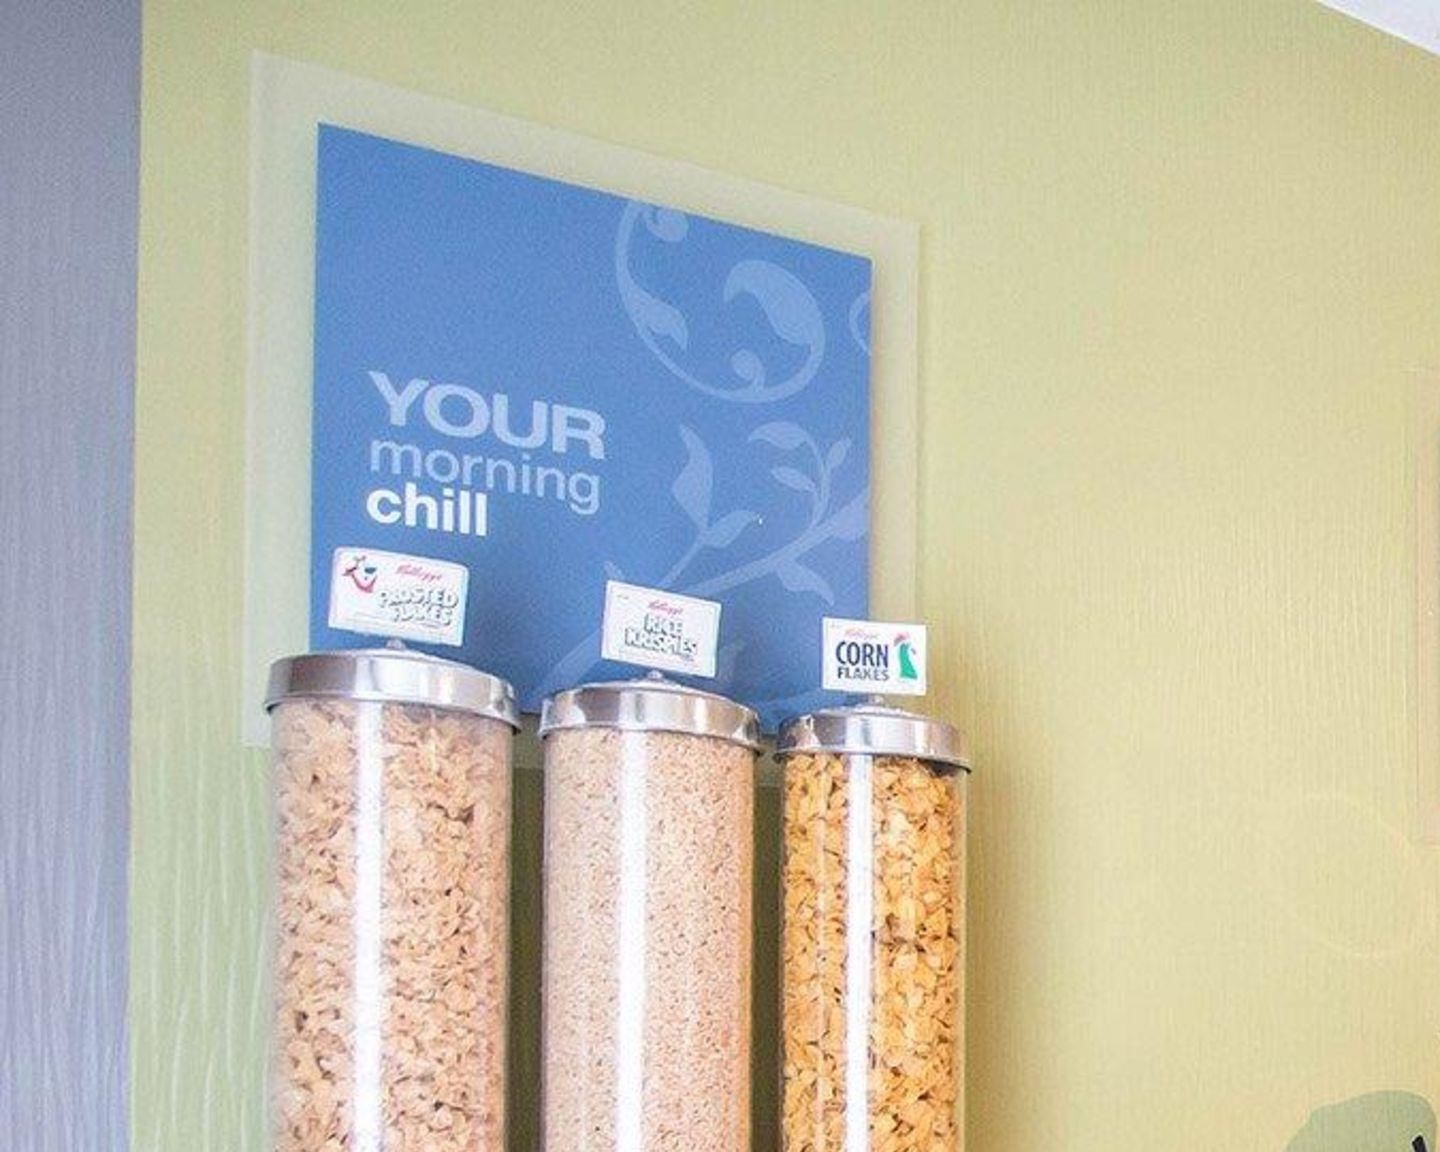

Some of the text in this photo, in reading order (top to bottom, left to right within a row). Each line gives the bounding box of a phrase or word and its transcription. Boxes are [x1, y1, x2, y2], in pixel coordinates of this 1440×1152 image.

[368, 370, 606, 459] YOUR
[370, 439, 600, 515] morning
[366, 481, 488, 537] chill
[835, 640, 889, 668] CORN
[837, 666, 890, 681] FLAKES
